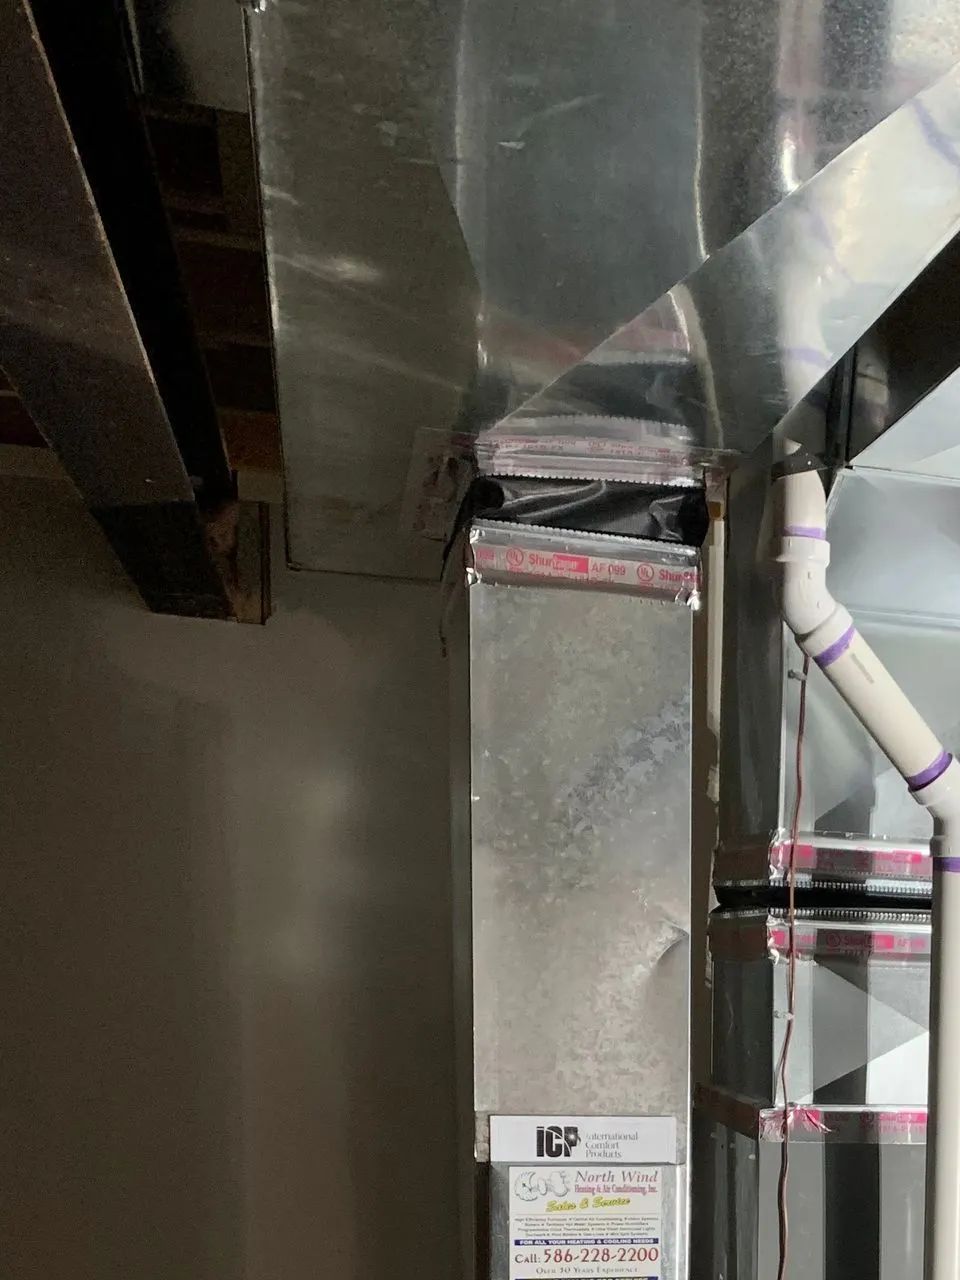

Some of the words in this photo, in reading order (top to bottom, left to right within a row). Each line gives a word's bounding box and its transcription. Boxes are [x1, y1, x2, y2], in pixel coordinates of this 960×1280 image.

[585, 1141, 619, 1150] Comfort
[585, 1150, 622, 1158] Products
[575, 1170, 614, 1182] North
[622, 1170, 658, 1182] Wind
[575, 1184, 595, 1195] Heating
[596, 1185, 602, 1193] &
[603, 1184, 611, 1193] Air
[544, 1247, 659, 1263] 586-228-2200
